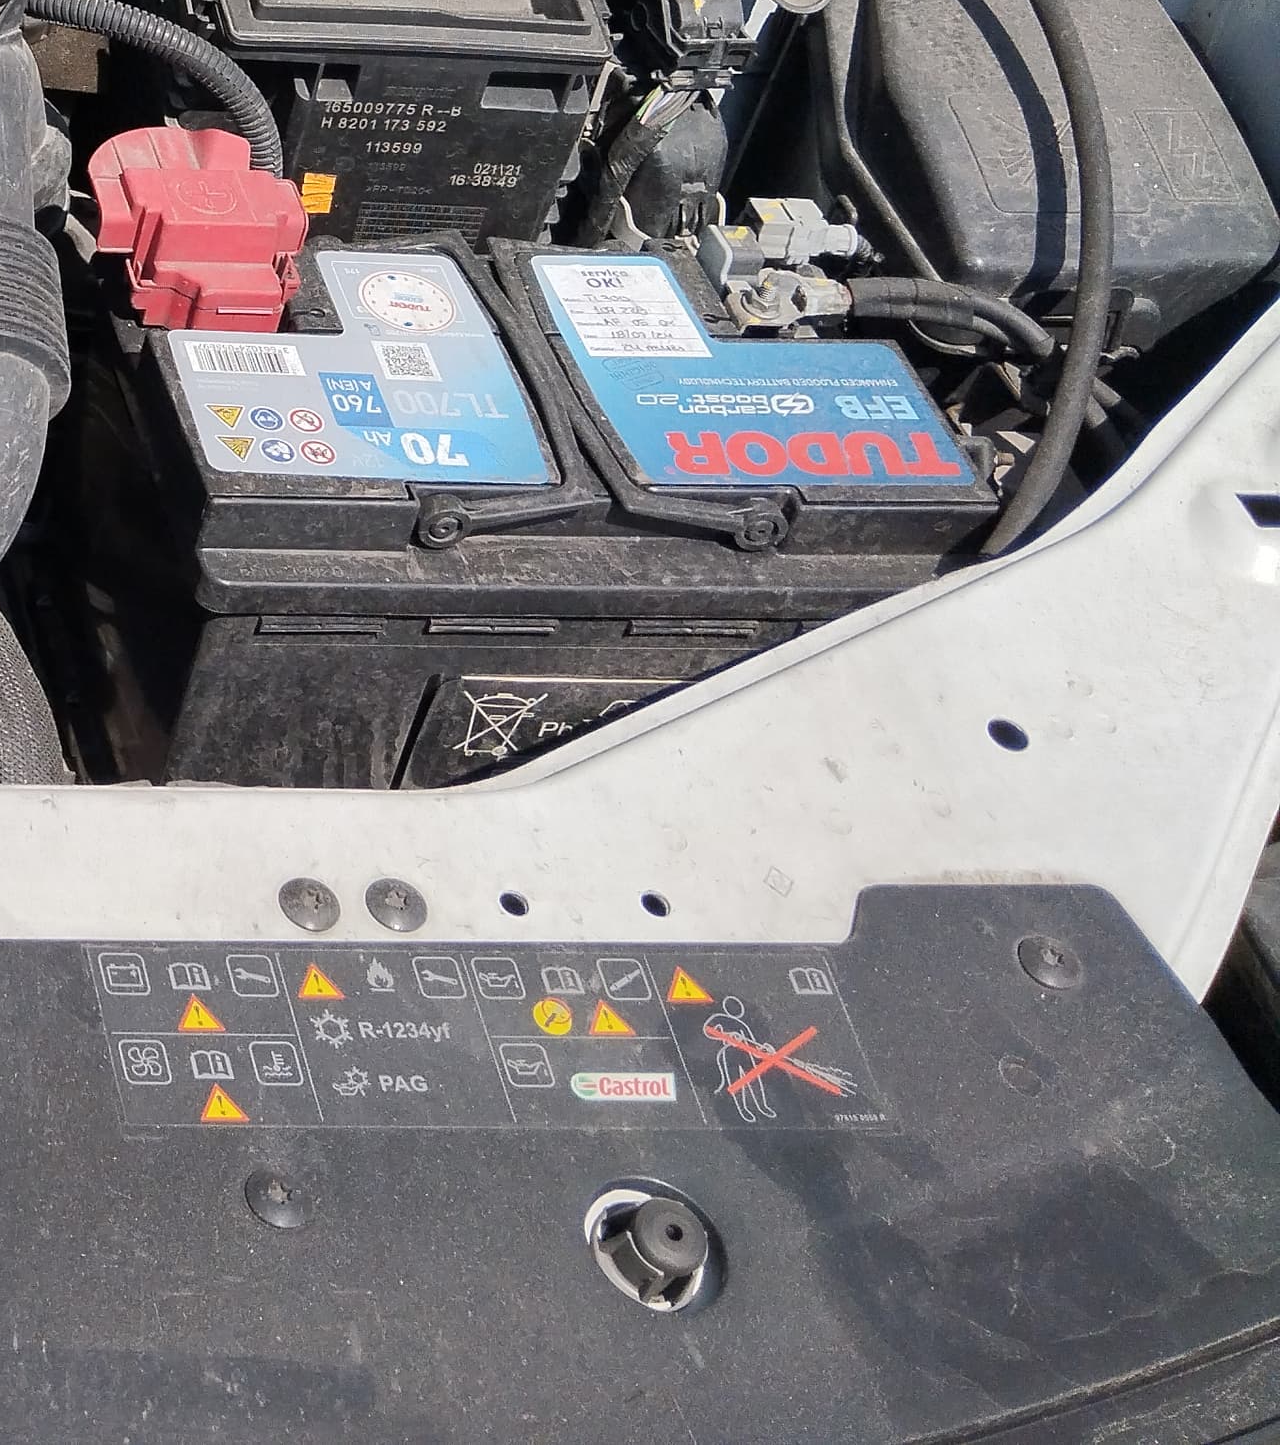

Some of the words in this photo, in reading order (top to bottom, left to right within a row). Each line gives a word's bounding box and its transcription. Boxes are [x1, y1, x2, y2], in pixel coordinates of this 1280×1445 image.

[324, 102, 416, 116] 165009775
[421, 104, 434, 116] R
[321, 116, 333, 129] H
[338, 117, 377, 130] 8201
[384, 118, 409, 131] 173
[416, 120, 447, 132] 592
[365, 141, 422, 154] 113599
[585, 277, 624, 289] OK!
[389, 300, 432, 312] TUDOR
[678, 377, 746, 387] TECHNOLOGY
[746, 377, 791, 387] BATTERY
[793, 377, 841, 387] FLOODED
[841, 377, 898, 387] ENHANCED
[332, 394, 382, 414] 760
[391, 390, 509, 419] TL700
[679, 404, 772, 417] carbon
[834, 395, 920, 420] EFB
[363, 430, 392, 447] Ah
[400, 432, 470, 467] 70
[664, 430, 961, 477] TUDOR
[358, 1020, 452, 1043] R-1234yf
[377, 1074, 429, 1093] PAG
[598, 1075, 673, 1098] Castrol
